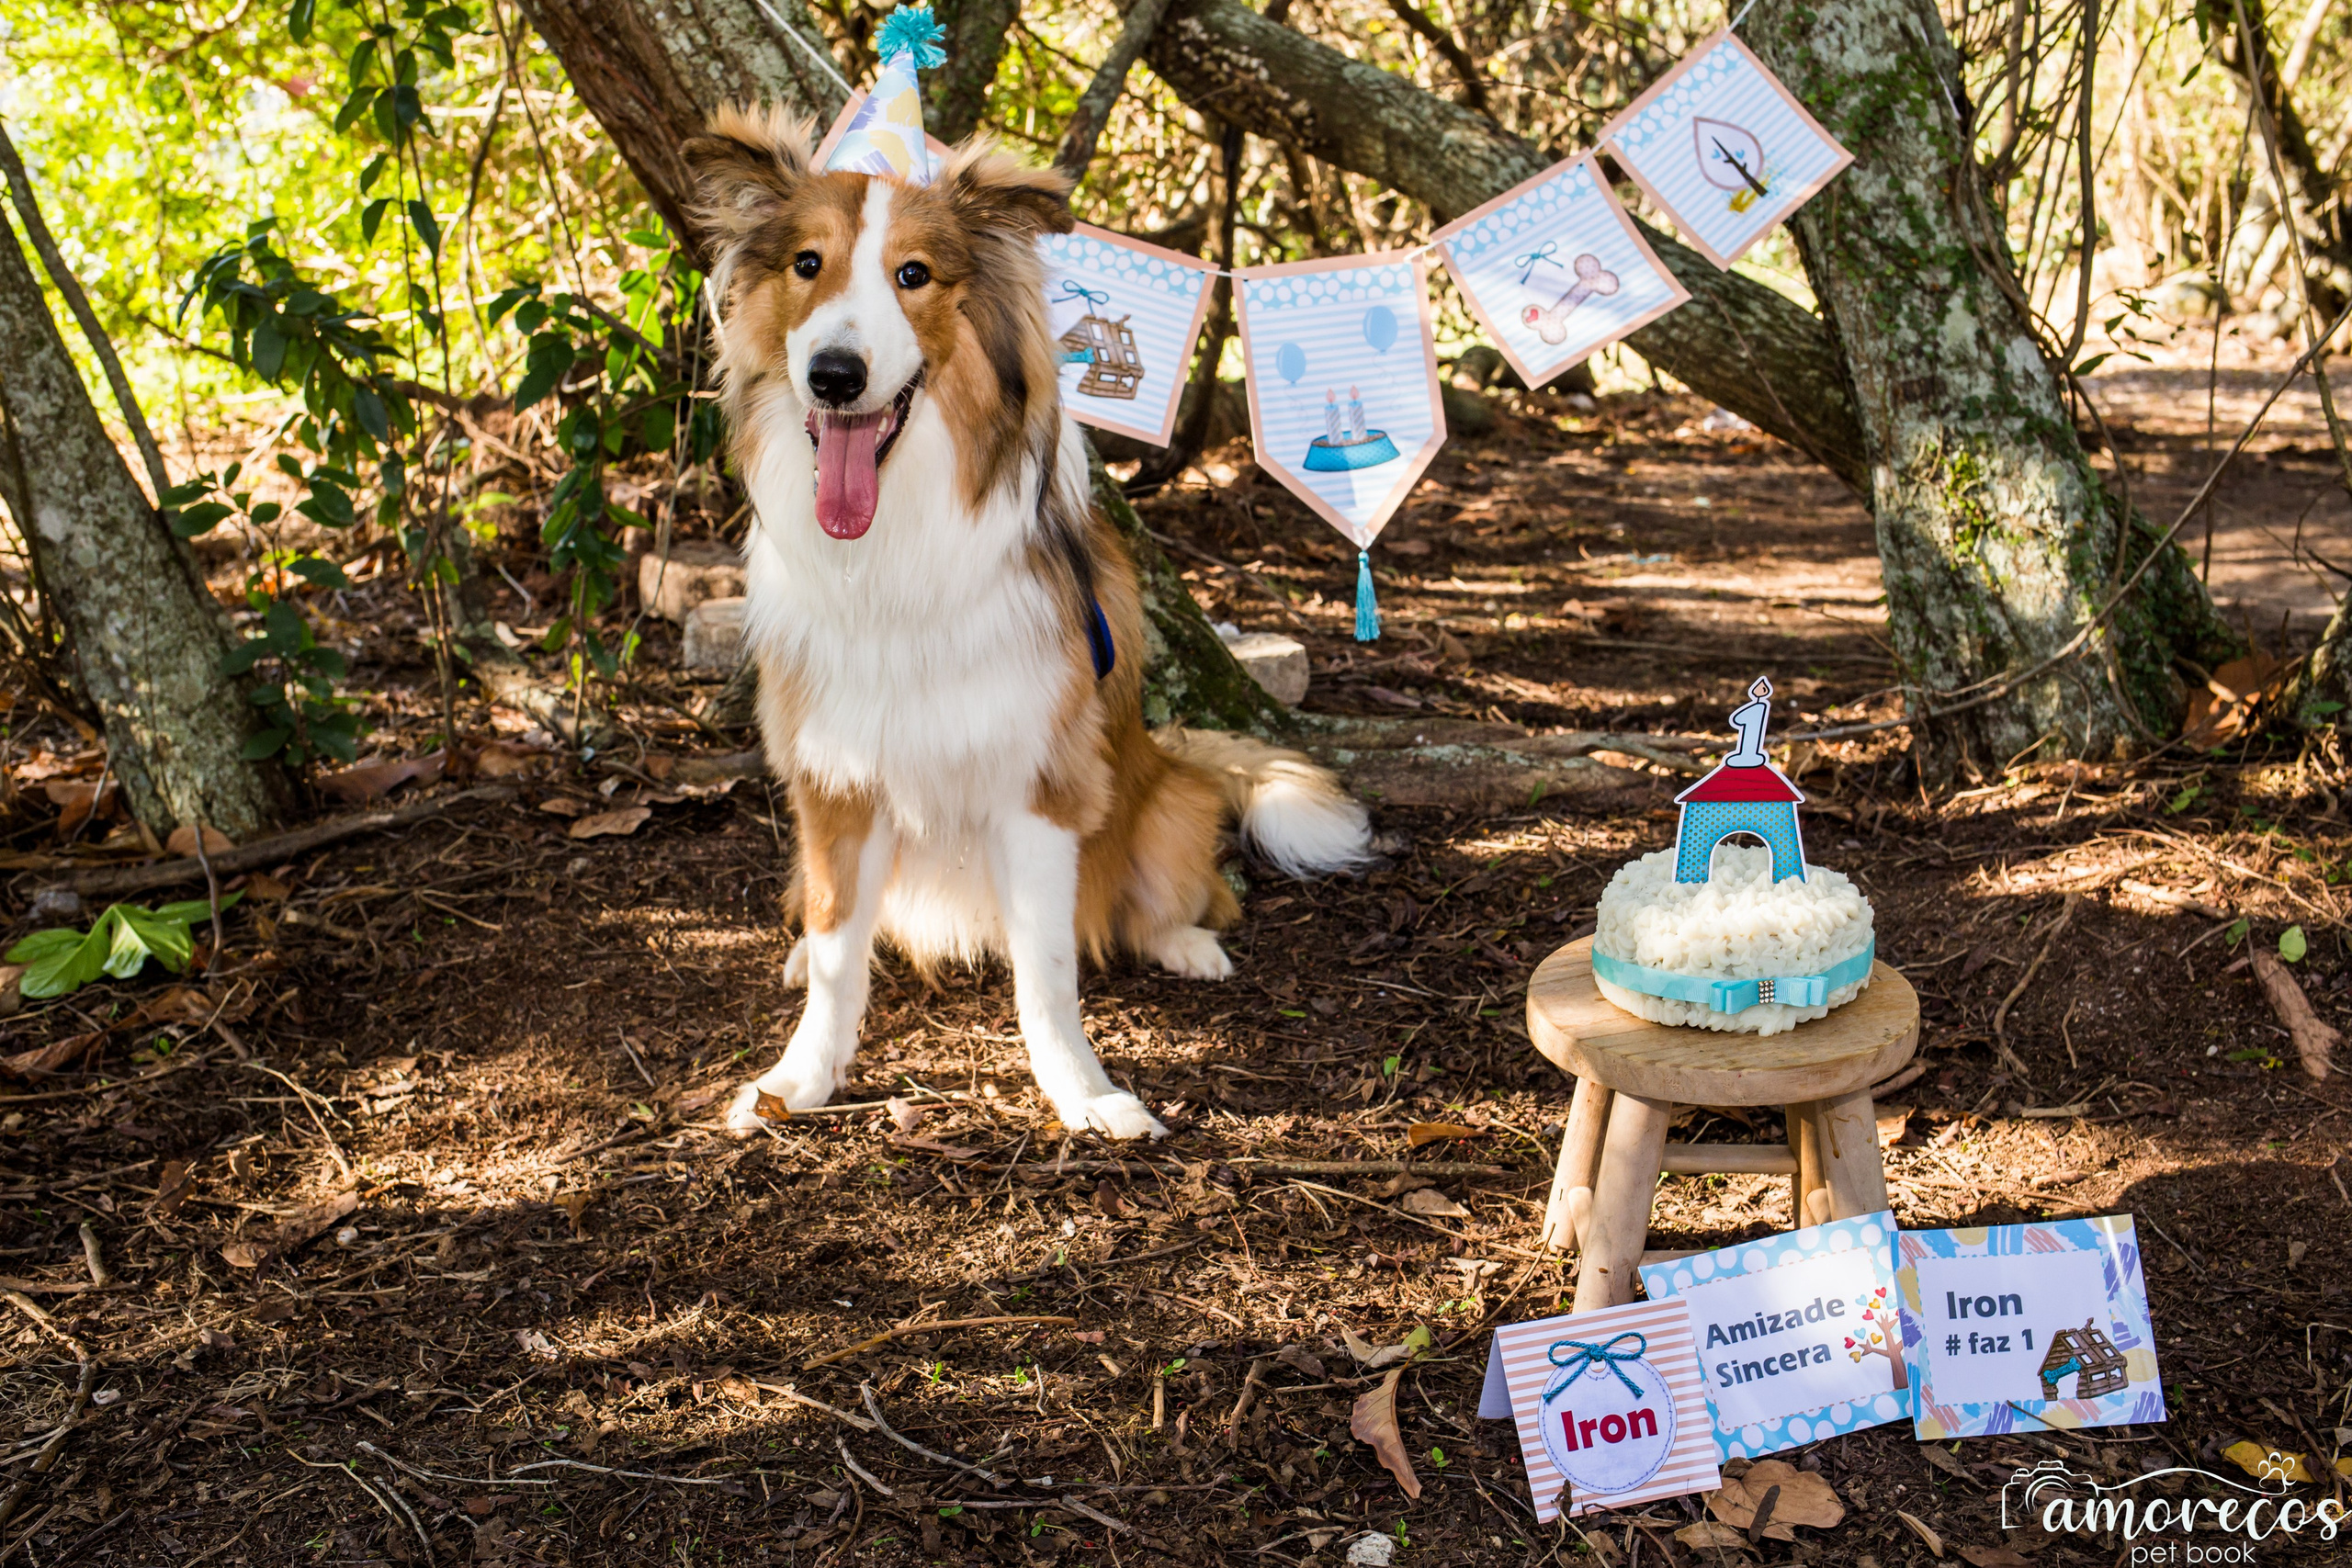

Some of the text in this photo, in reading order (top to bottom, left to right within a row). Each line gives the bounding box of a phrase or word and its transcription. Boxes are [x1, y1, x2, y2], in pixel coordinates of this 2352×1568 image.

[1724, 702, 1766, 769] 1
[1705, 1296, 1846, 1350] Amizade
[1946, 1291, 2023, 1320] Iron
[1945, 1328, 2034, 1357] # faz 1
[1715, 1343, 1833, 1389] Sincera
[1560, 1407, 1659, 1453] Iron
